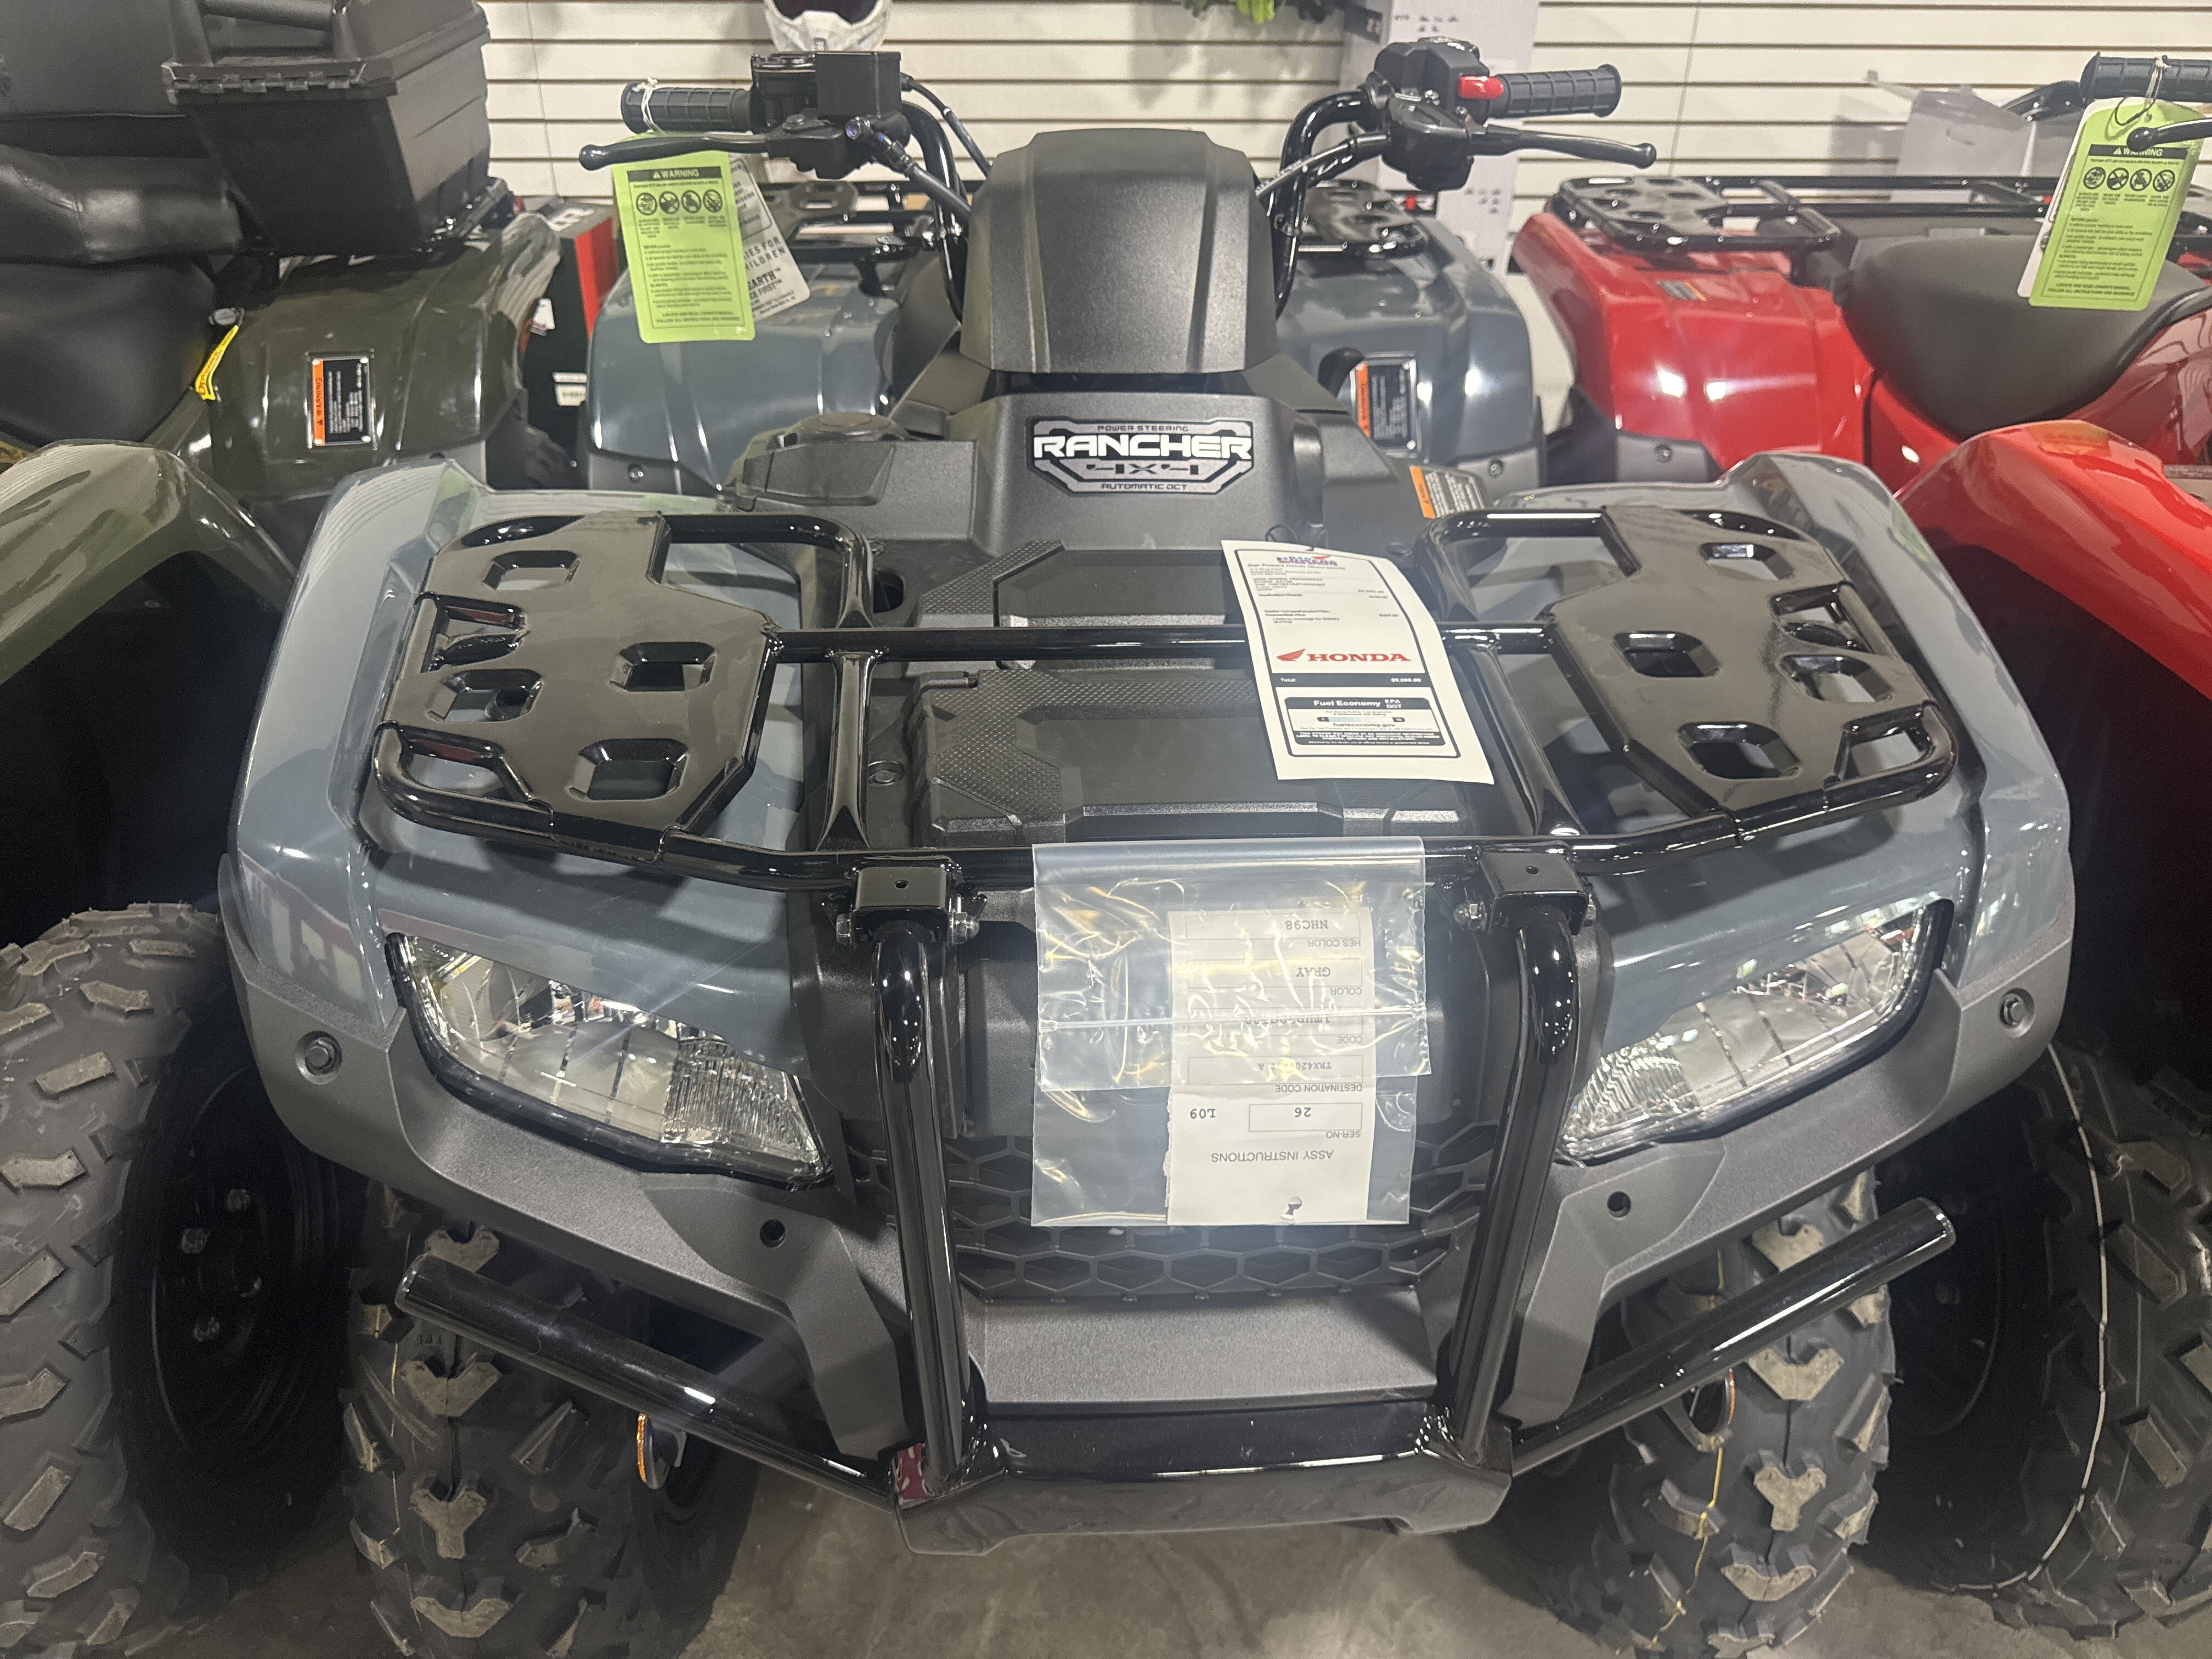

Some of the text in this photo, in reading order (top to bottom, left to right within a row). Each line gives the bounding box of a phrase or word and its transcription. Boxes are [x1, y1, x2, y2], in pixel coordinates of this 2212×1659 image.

[662, 169, 699, 178] WARNING
[744, 236, 781, 259] IES FOR
[1034, 435, 1252, 460] RANCHER
[1307, 653, 1411, 662] HONDA
[1285, 919, 1329, 929] NHC98
[1307, 939, 1361, 947] HES COLOR
[1296, 966, 1330, 977] GRAY
[1330, 987, 1362, 995] COLOR
[1336, 1035, 1363, 1043] CODE
[1274, 1084, 1362, 1093] DESTINATION CODE
[1189, 1107, 1311, 1119] 26 L09
[1325, 1130, 1361, 1138] SER-NO.
[1211, 1150, 1334, 1163] ASSY INSTRUCTIONS
